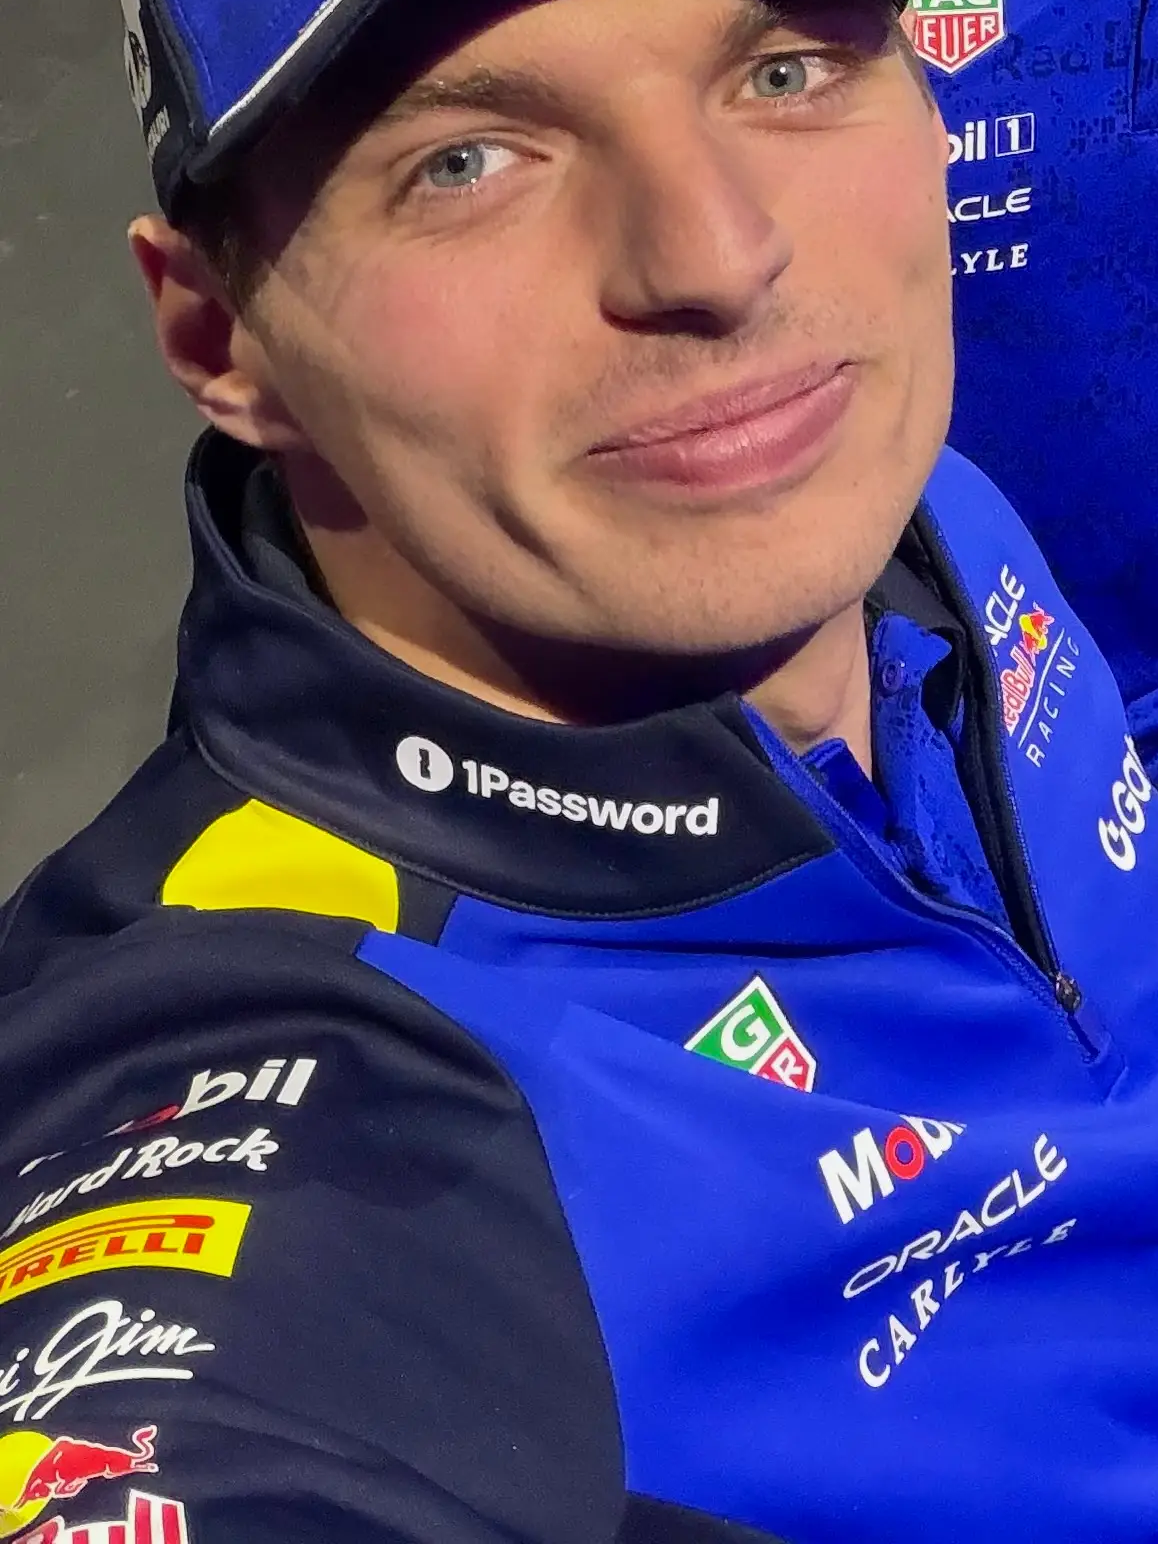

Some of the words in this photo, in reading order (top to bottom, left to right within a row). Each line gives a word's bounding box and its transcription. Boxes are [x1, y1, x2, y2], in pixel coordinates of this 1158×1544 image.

[914, 14, 998, 63] EUER
[1025, 636, 1080, 769] RACING
[461, 758, 719, 836] 1Password
[0, 1232, 206, 1292] IRELLI
[842, 1132, 1068, 1300] ORACLE
[858, 1218, 1077, 1388] CARLYLE
